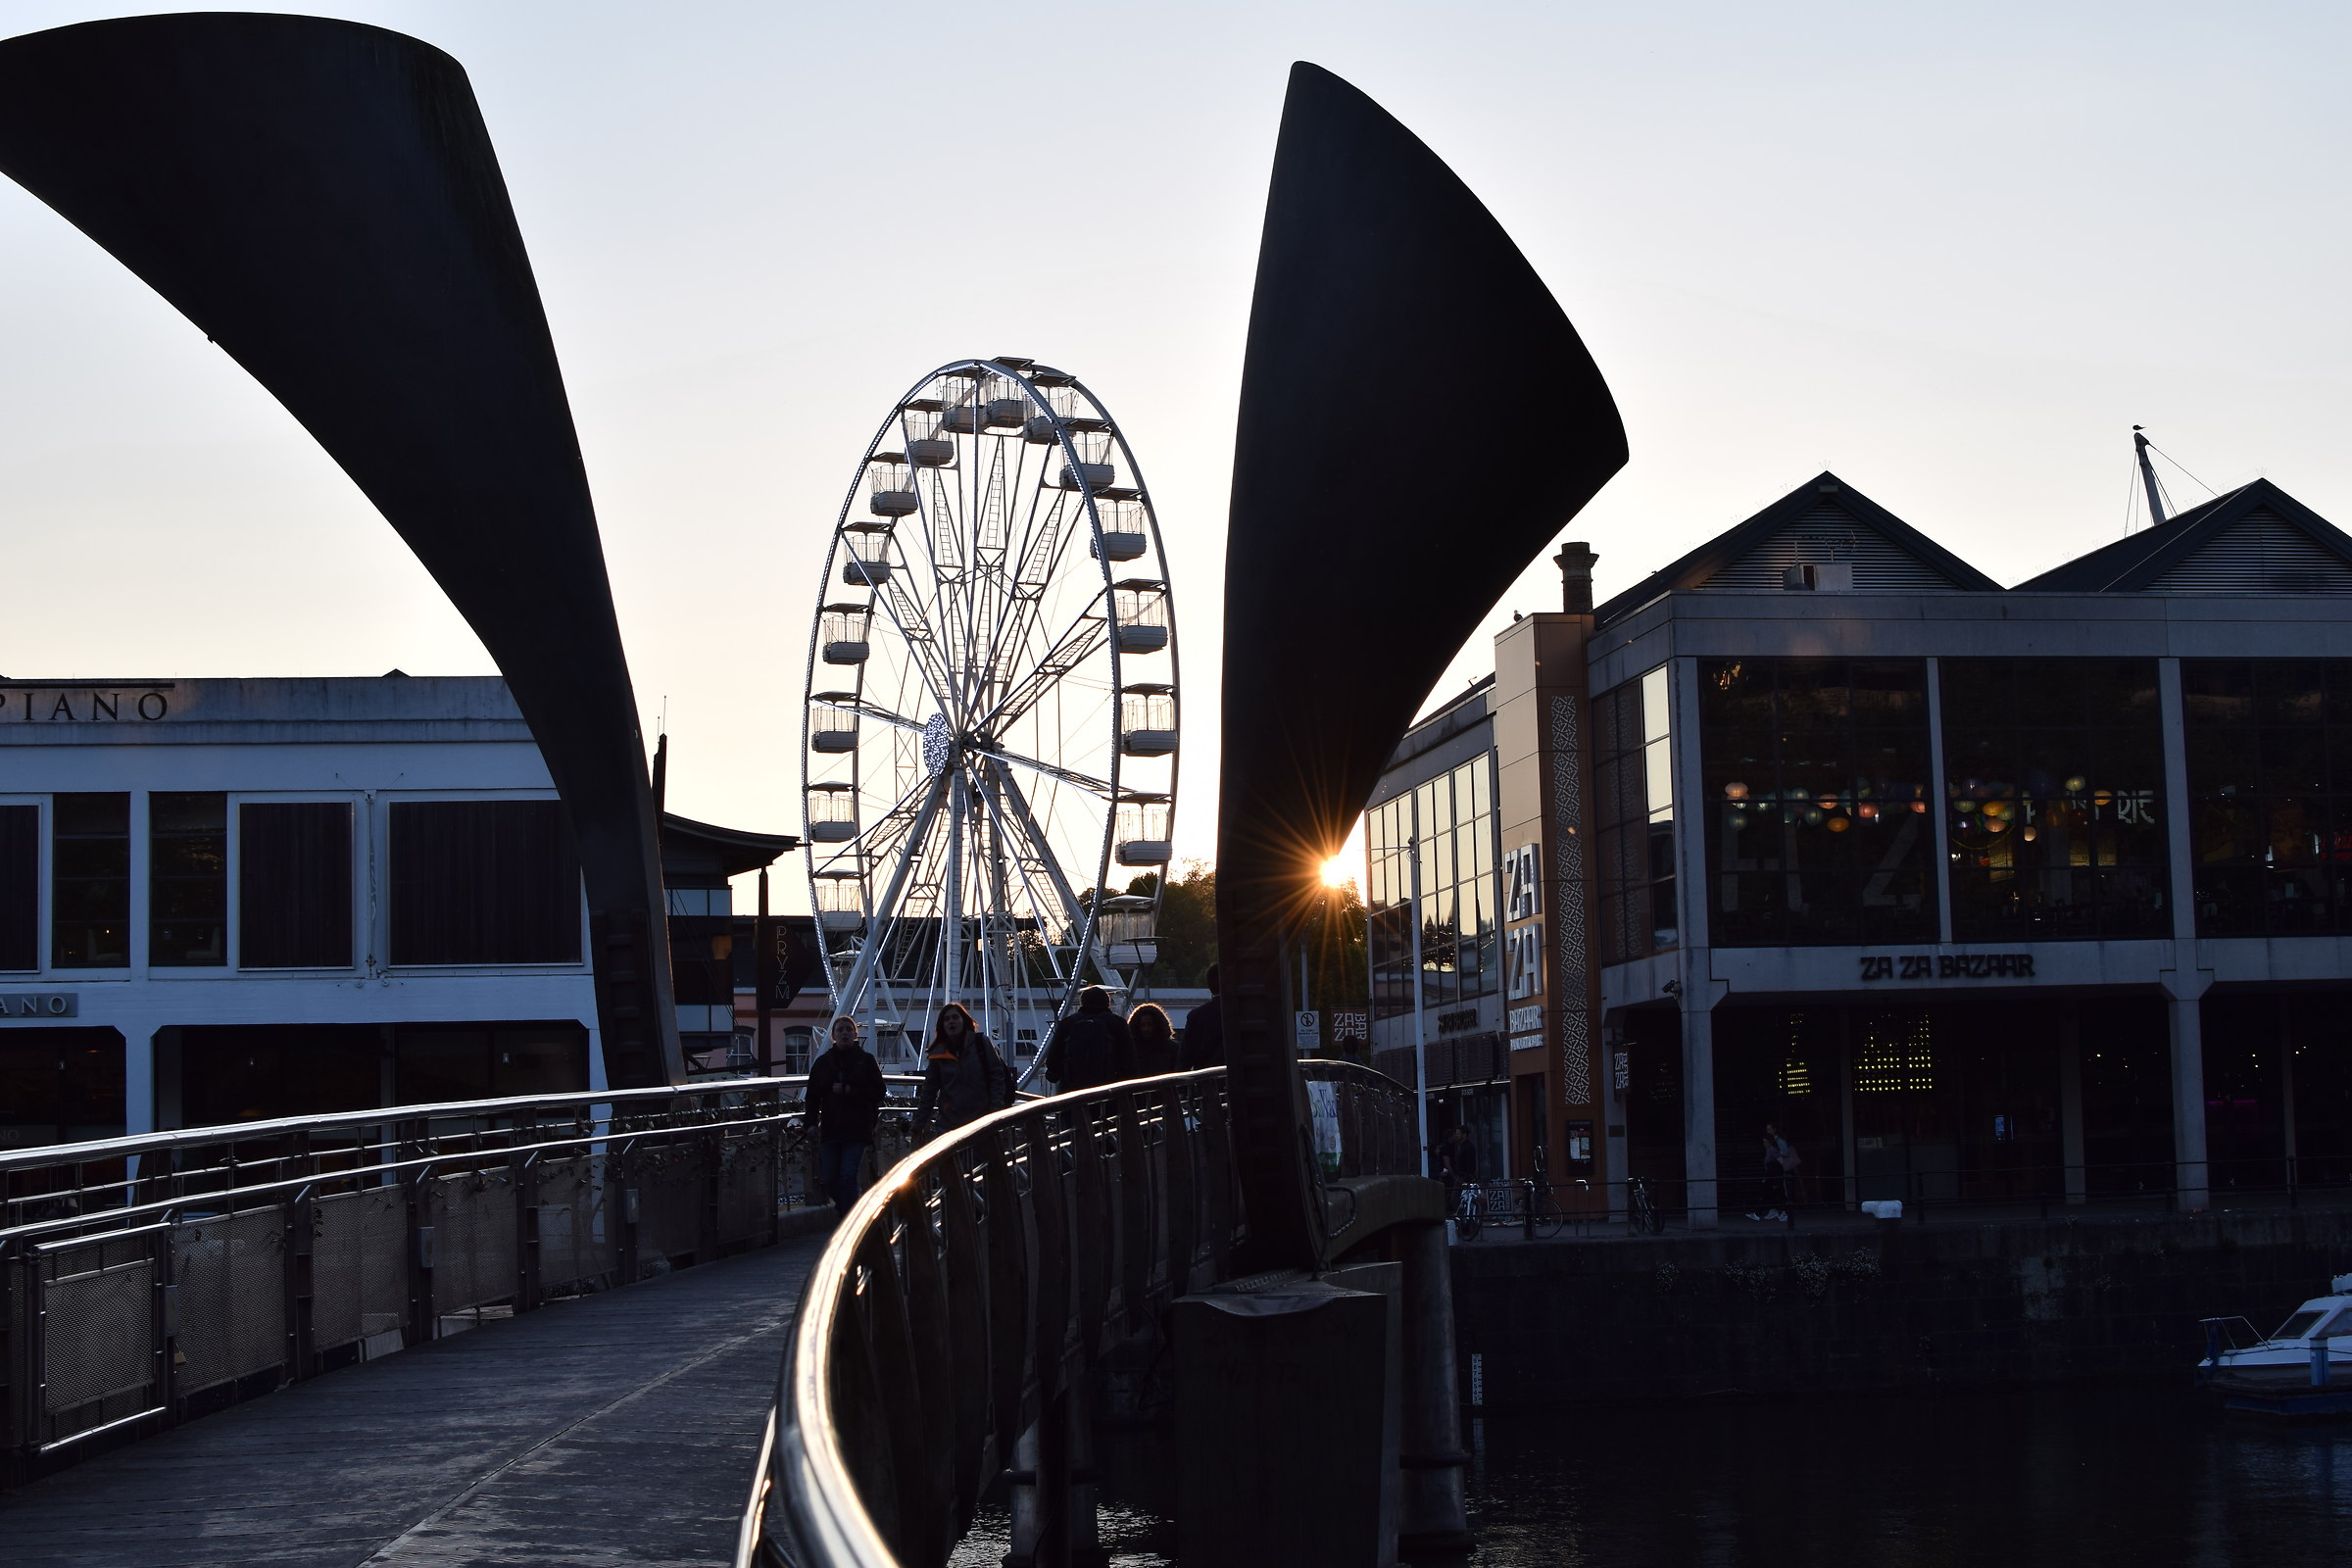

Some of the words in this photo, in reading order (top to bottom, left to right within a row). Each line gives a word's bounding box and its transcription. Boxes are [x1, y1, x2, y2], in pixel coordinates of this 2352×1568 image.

[1504, 842, 1540, 922] ZA
[775, 925, 790, 1000] PRYZM
[1507, 923, 1543, 1001] ZA
[1859, 956, 1893, 980] ZA
[1899, 956, 1933, 979] ZA
[1937, 954, 2036, 979] BAZAAR
[1334, 1012, 1354, 1027] ZA
[1354, 1012, 1367, 1040] BAR
[1508, 1004, 1544, 1034] BAZAAR
[1490, 1191, 1504, 1200] ZA
[1491, 1200, 1505, 1210] ZA
